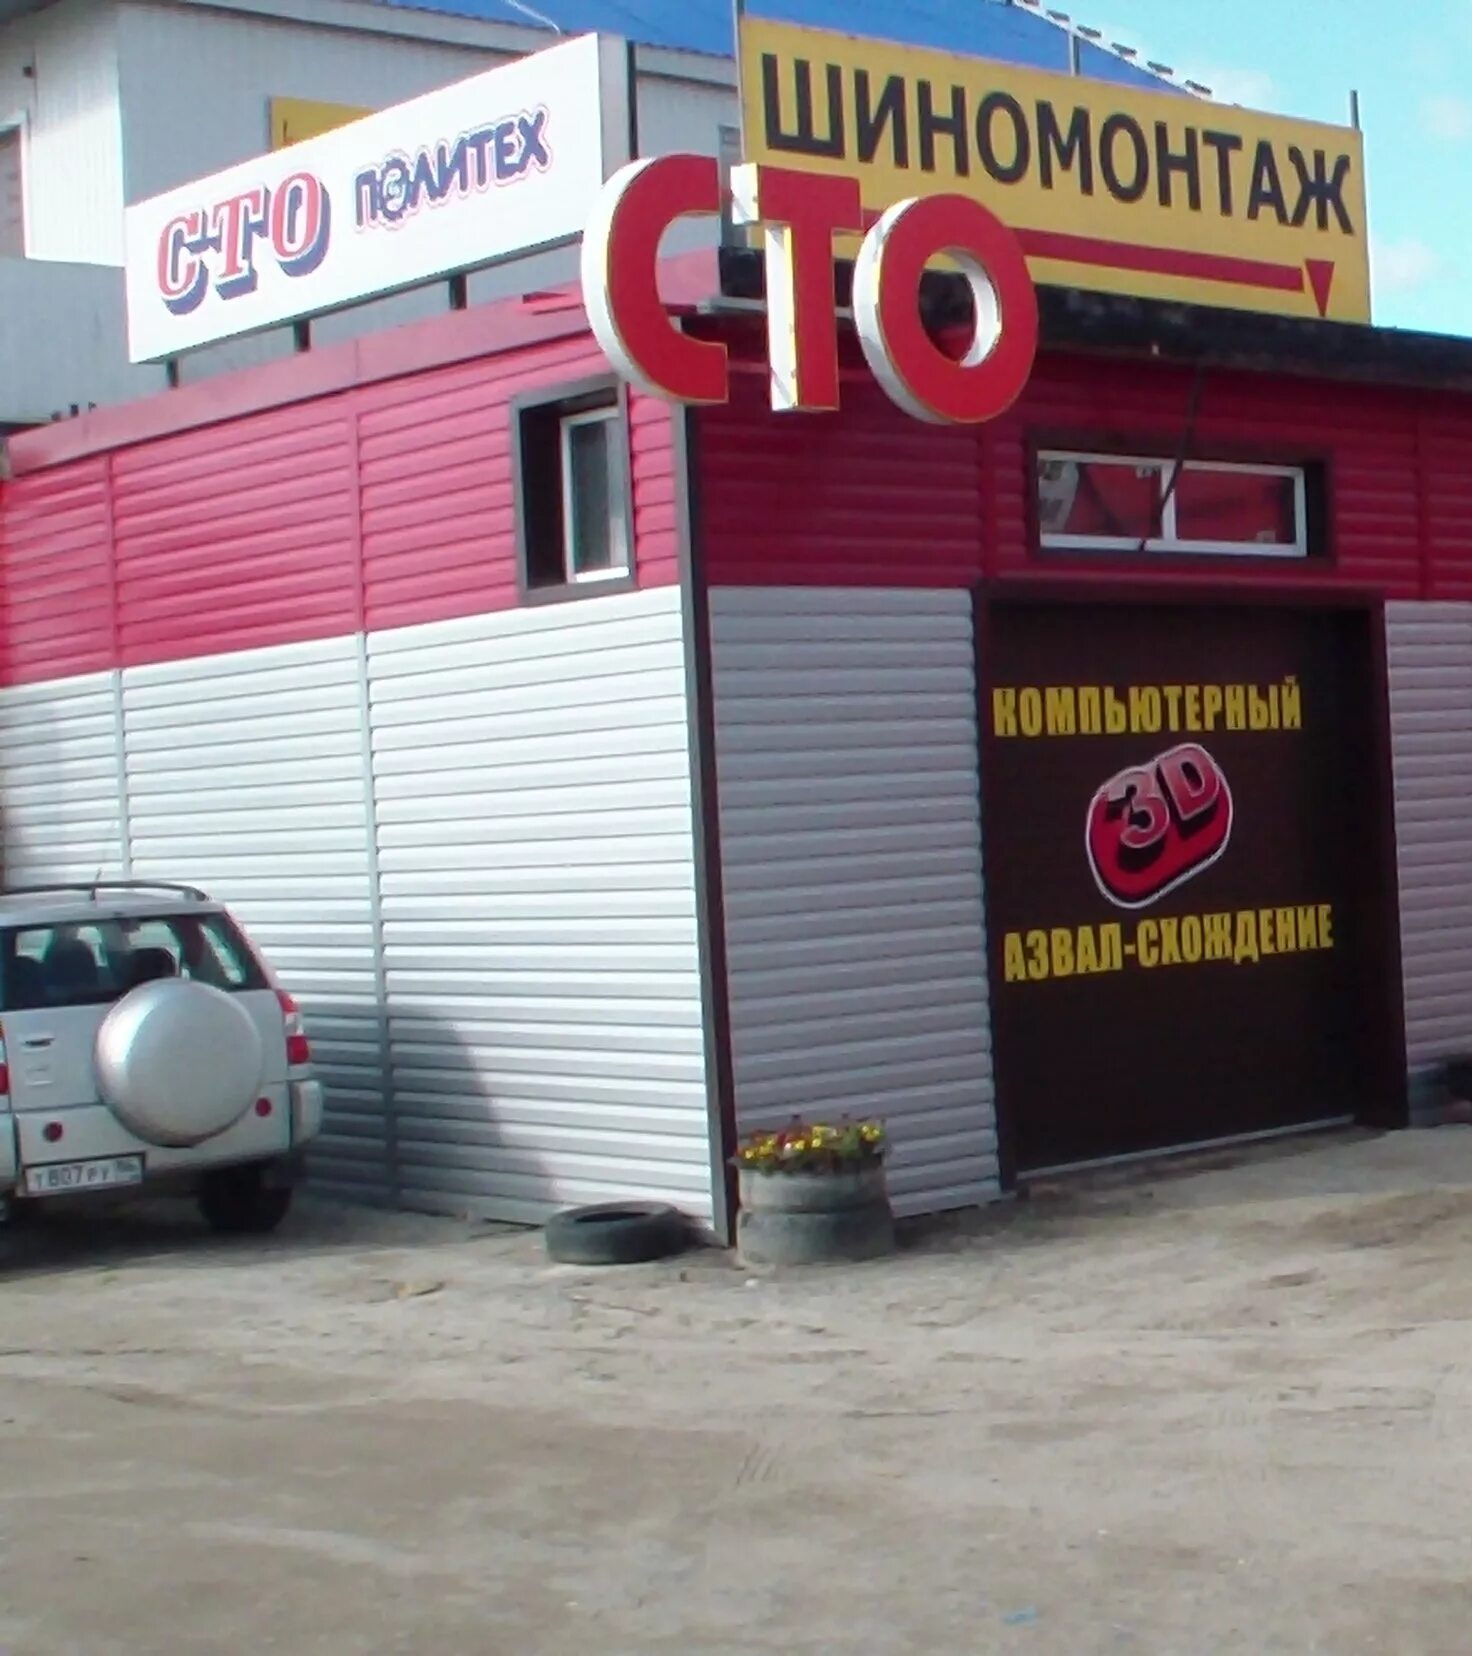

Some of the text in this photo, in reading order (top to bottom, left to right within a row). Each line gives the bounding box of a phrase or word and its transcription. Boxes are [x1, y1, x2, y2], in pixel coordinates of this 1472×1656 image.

[157, 107, 550, 316] СТО ПОЛИТЕХ
[762, 53, 1354, 234] ШИНОМОНТАЖ
[582, 153, 1038, 424] СТО
[993, 675, 1301, 737] КОМПЬЮТЕРНЫЙ
[1104, 748, 1220, 849] 3D
[1004, 904, 1334, 982] АЗВАЛ-СХОЖДЕНИЕ
